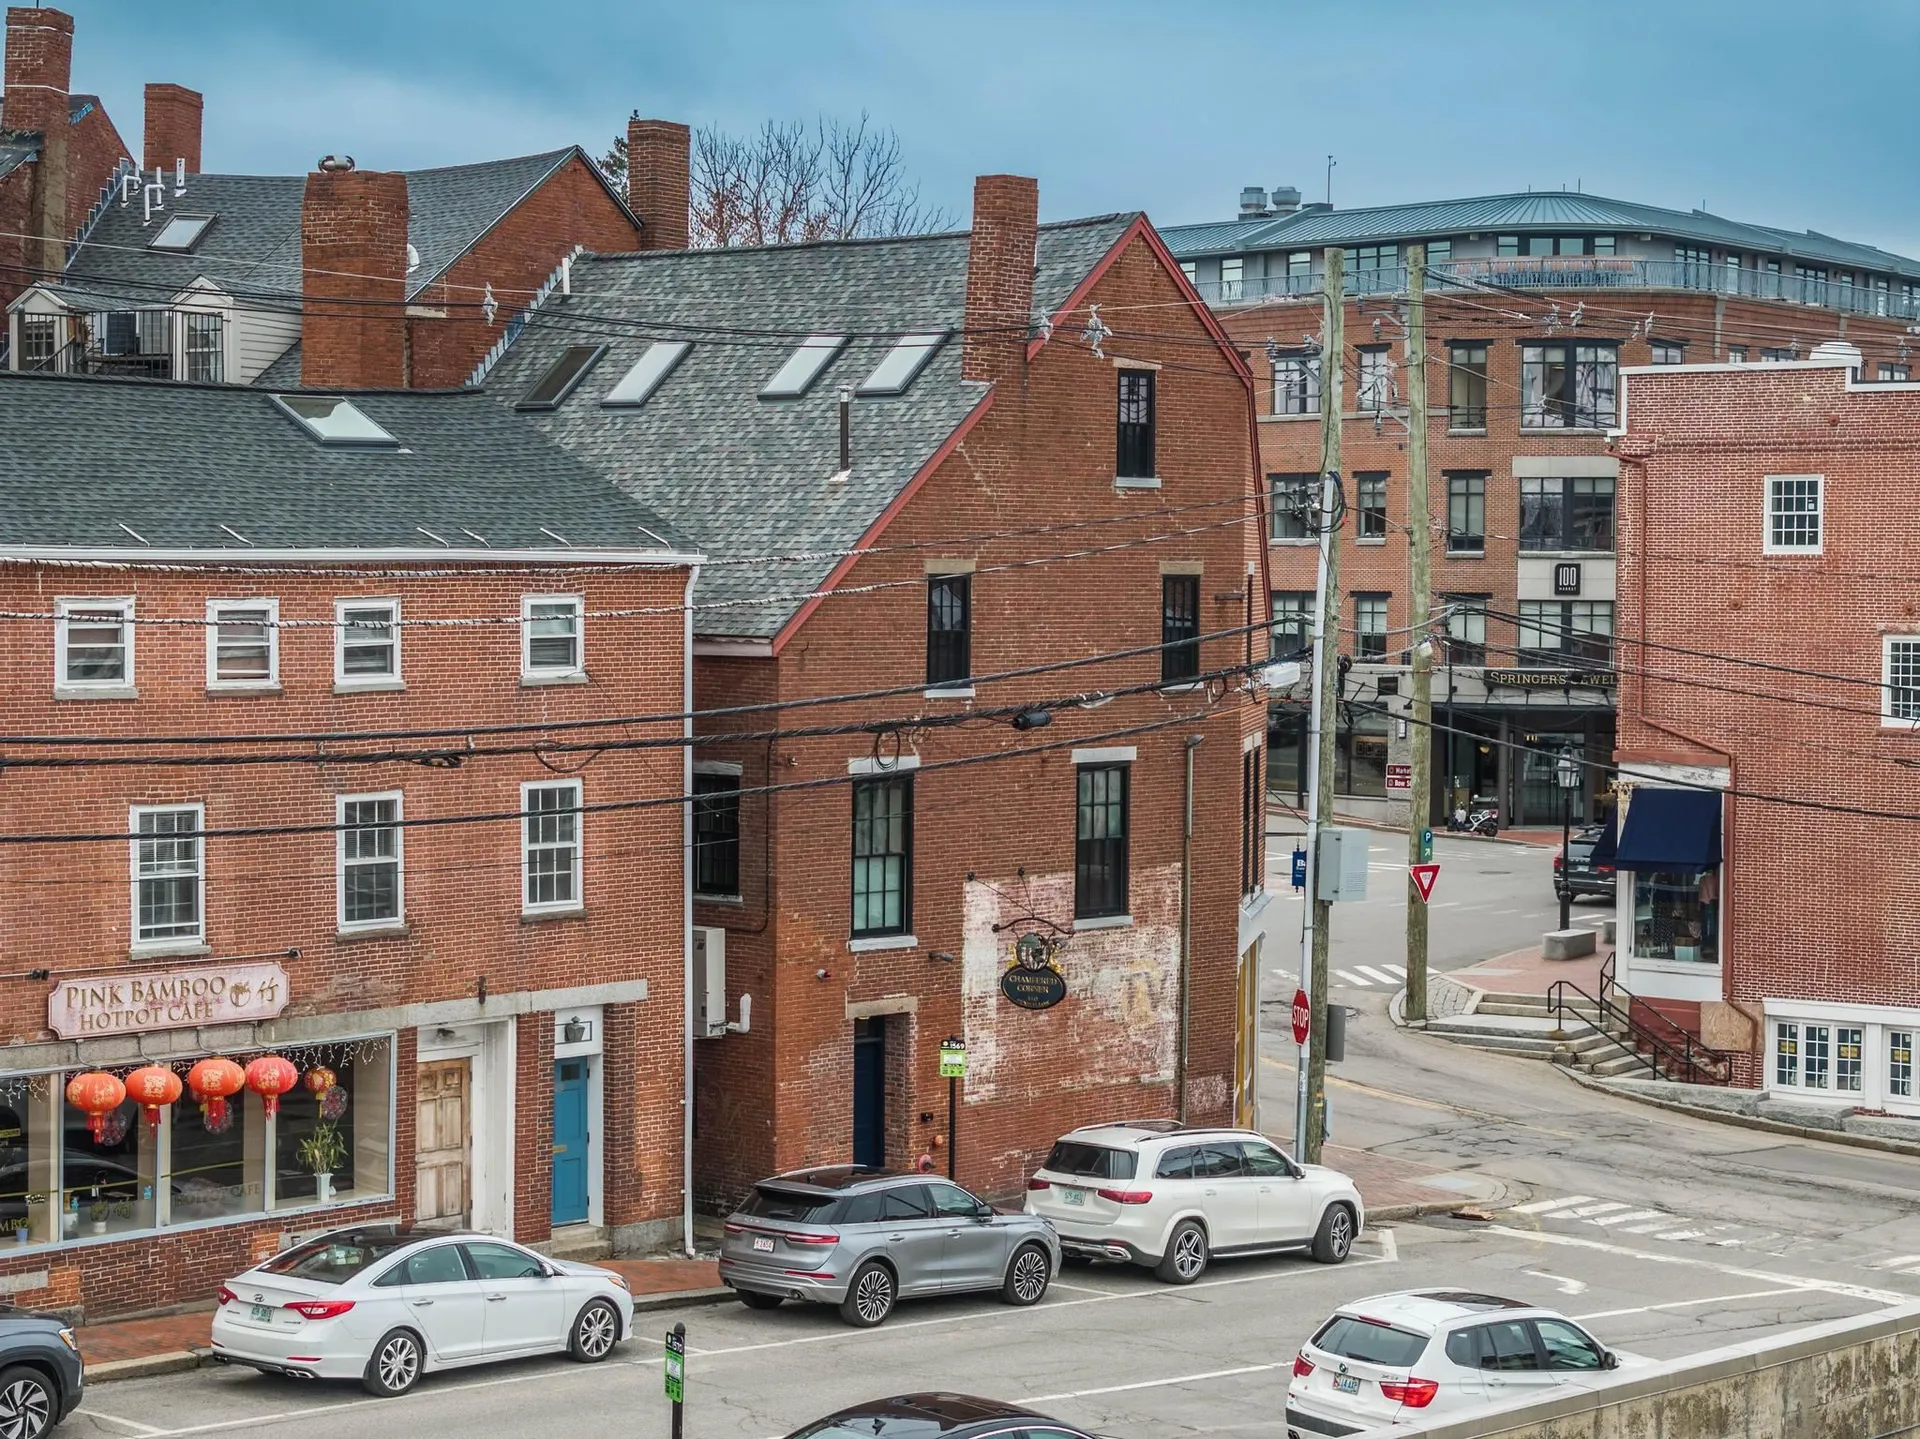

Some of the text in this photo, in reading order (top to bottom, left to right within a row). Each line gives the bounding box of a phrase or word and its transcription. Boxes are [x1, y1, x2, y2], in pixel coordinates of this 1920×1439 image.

[1559, 567, 1576, 586] 100
[66, 976, 226, 1009] PINK BAMBOO
[1016, 984, 1049, 994] CORNER
[80, 1006, 164, 1031] HOTPOT
[1292, 1006, 1309, 1029] STOP
